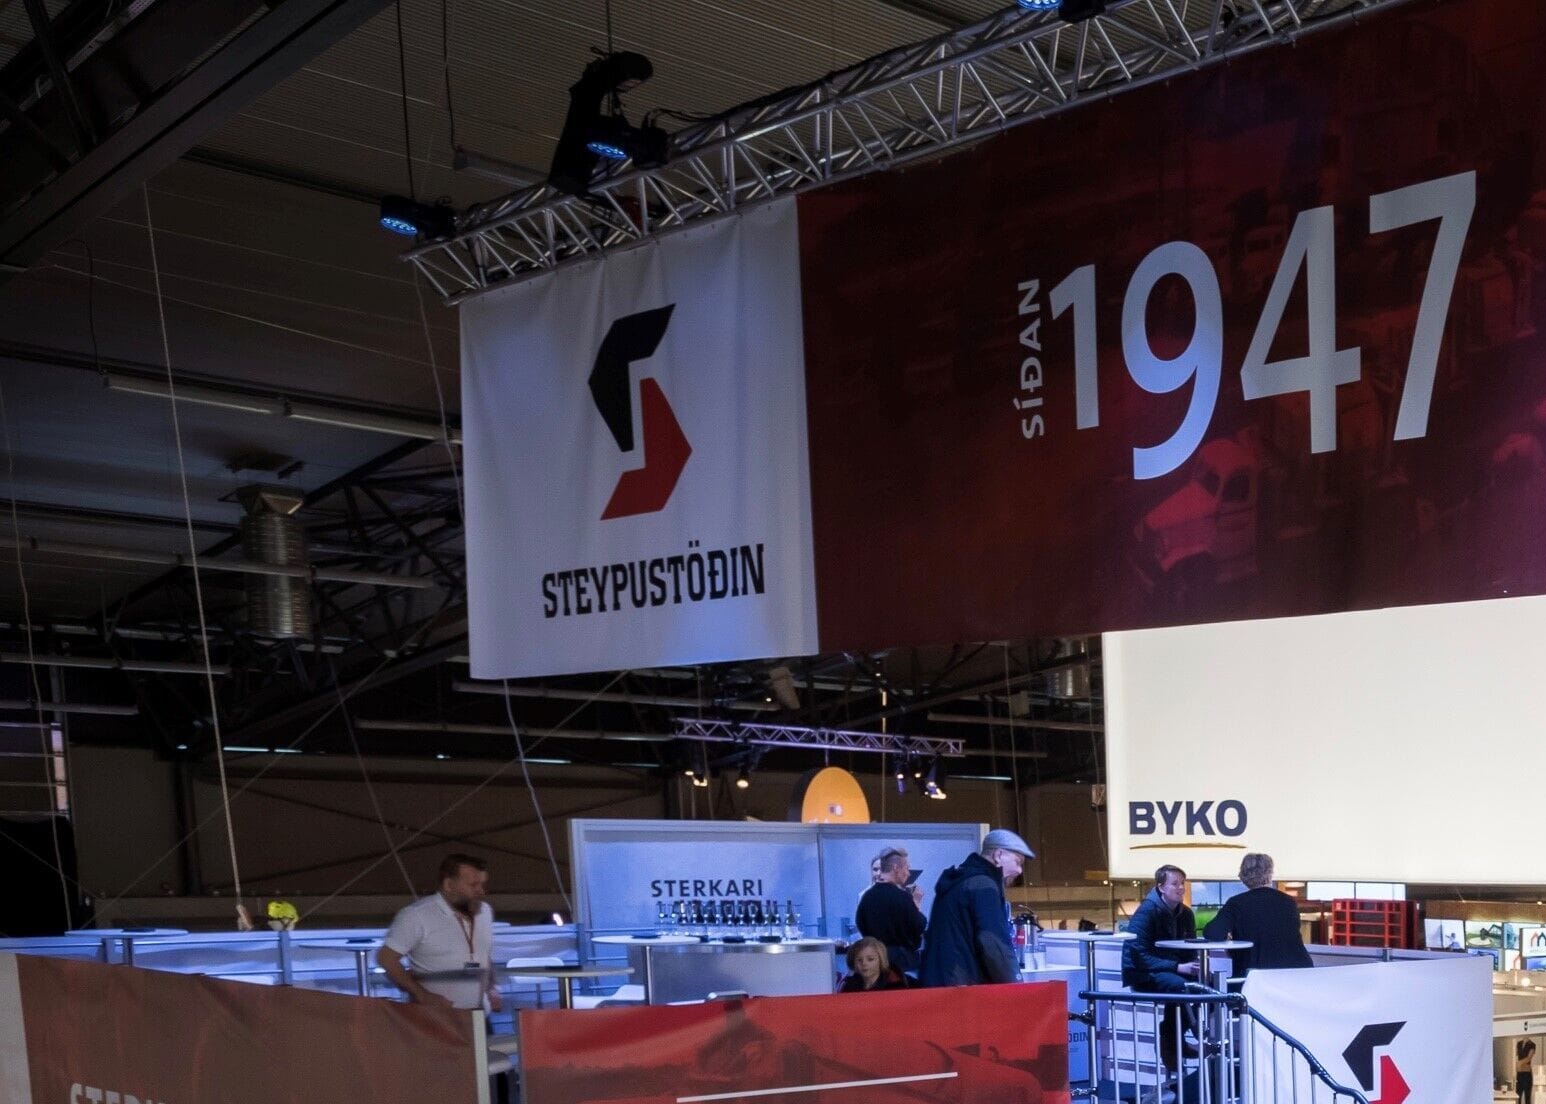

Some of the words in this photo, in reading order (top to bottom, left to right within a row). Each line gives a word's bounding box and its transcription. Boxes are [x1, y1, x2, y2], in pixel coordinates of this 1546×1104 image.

[1017, 278, 1045, 440] SÍÐAN
[1048, 169, 1477, 480] 1947
[541, 541, 766, 619] STEYPUSTÖÐIN
[1128, 799, 1248, 836] BYKO
[651, 879, 763, 898] STERKARI
